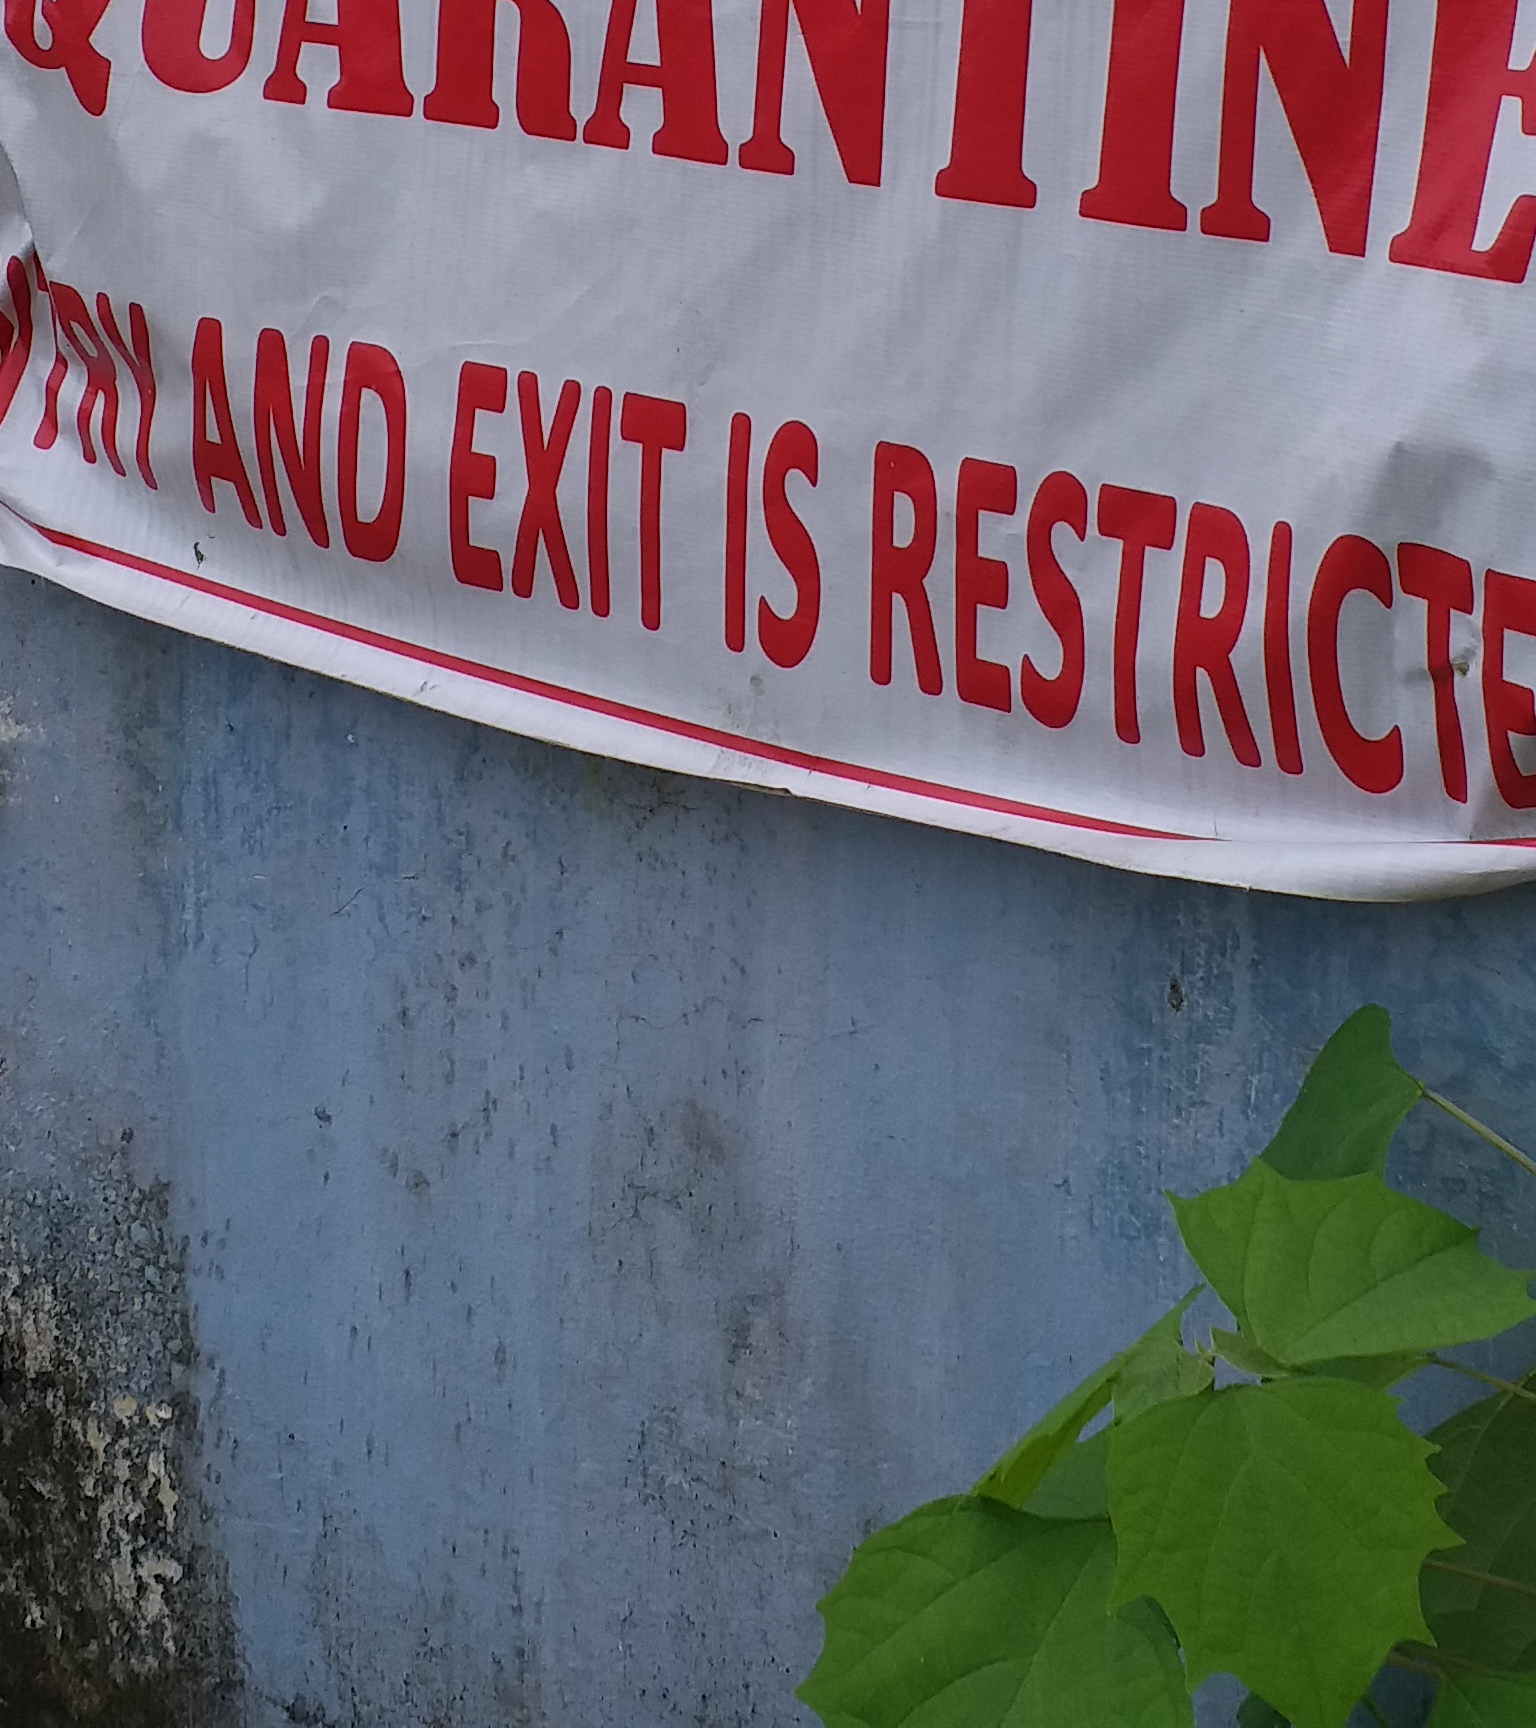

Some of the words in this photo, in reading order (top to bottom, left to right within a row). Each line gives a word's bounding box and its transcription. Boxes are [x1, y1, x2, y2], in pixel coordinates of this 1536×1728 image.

[191, 317, 407, 562] AND
[449, 360, 687, 632] EXIT
[724, 412, 821, 669] IS
